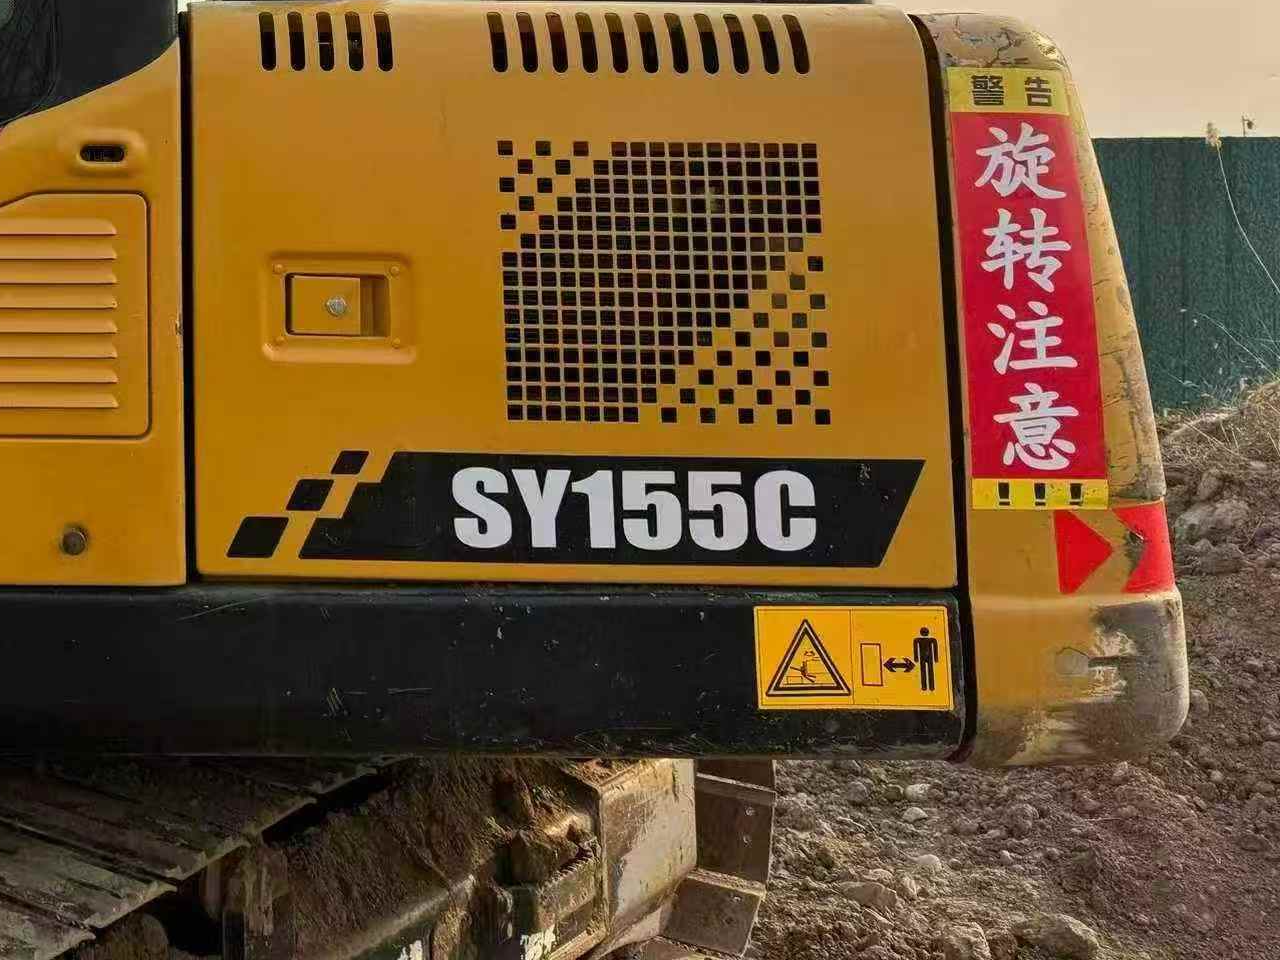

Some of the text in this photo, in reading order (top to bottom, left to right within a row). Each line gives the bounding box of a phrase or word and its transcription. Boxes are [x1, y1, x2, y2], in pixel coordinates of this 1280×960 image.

[970, 75, 1053, 107] 警告
[975, 121, 1079, 471] 旋转注意
[451, 467, 818, 552] SY155C
